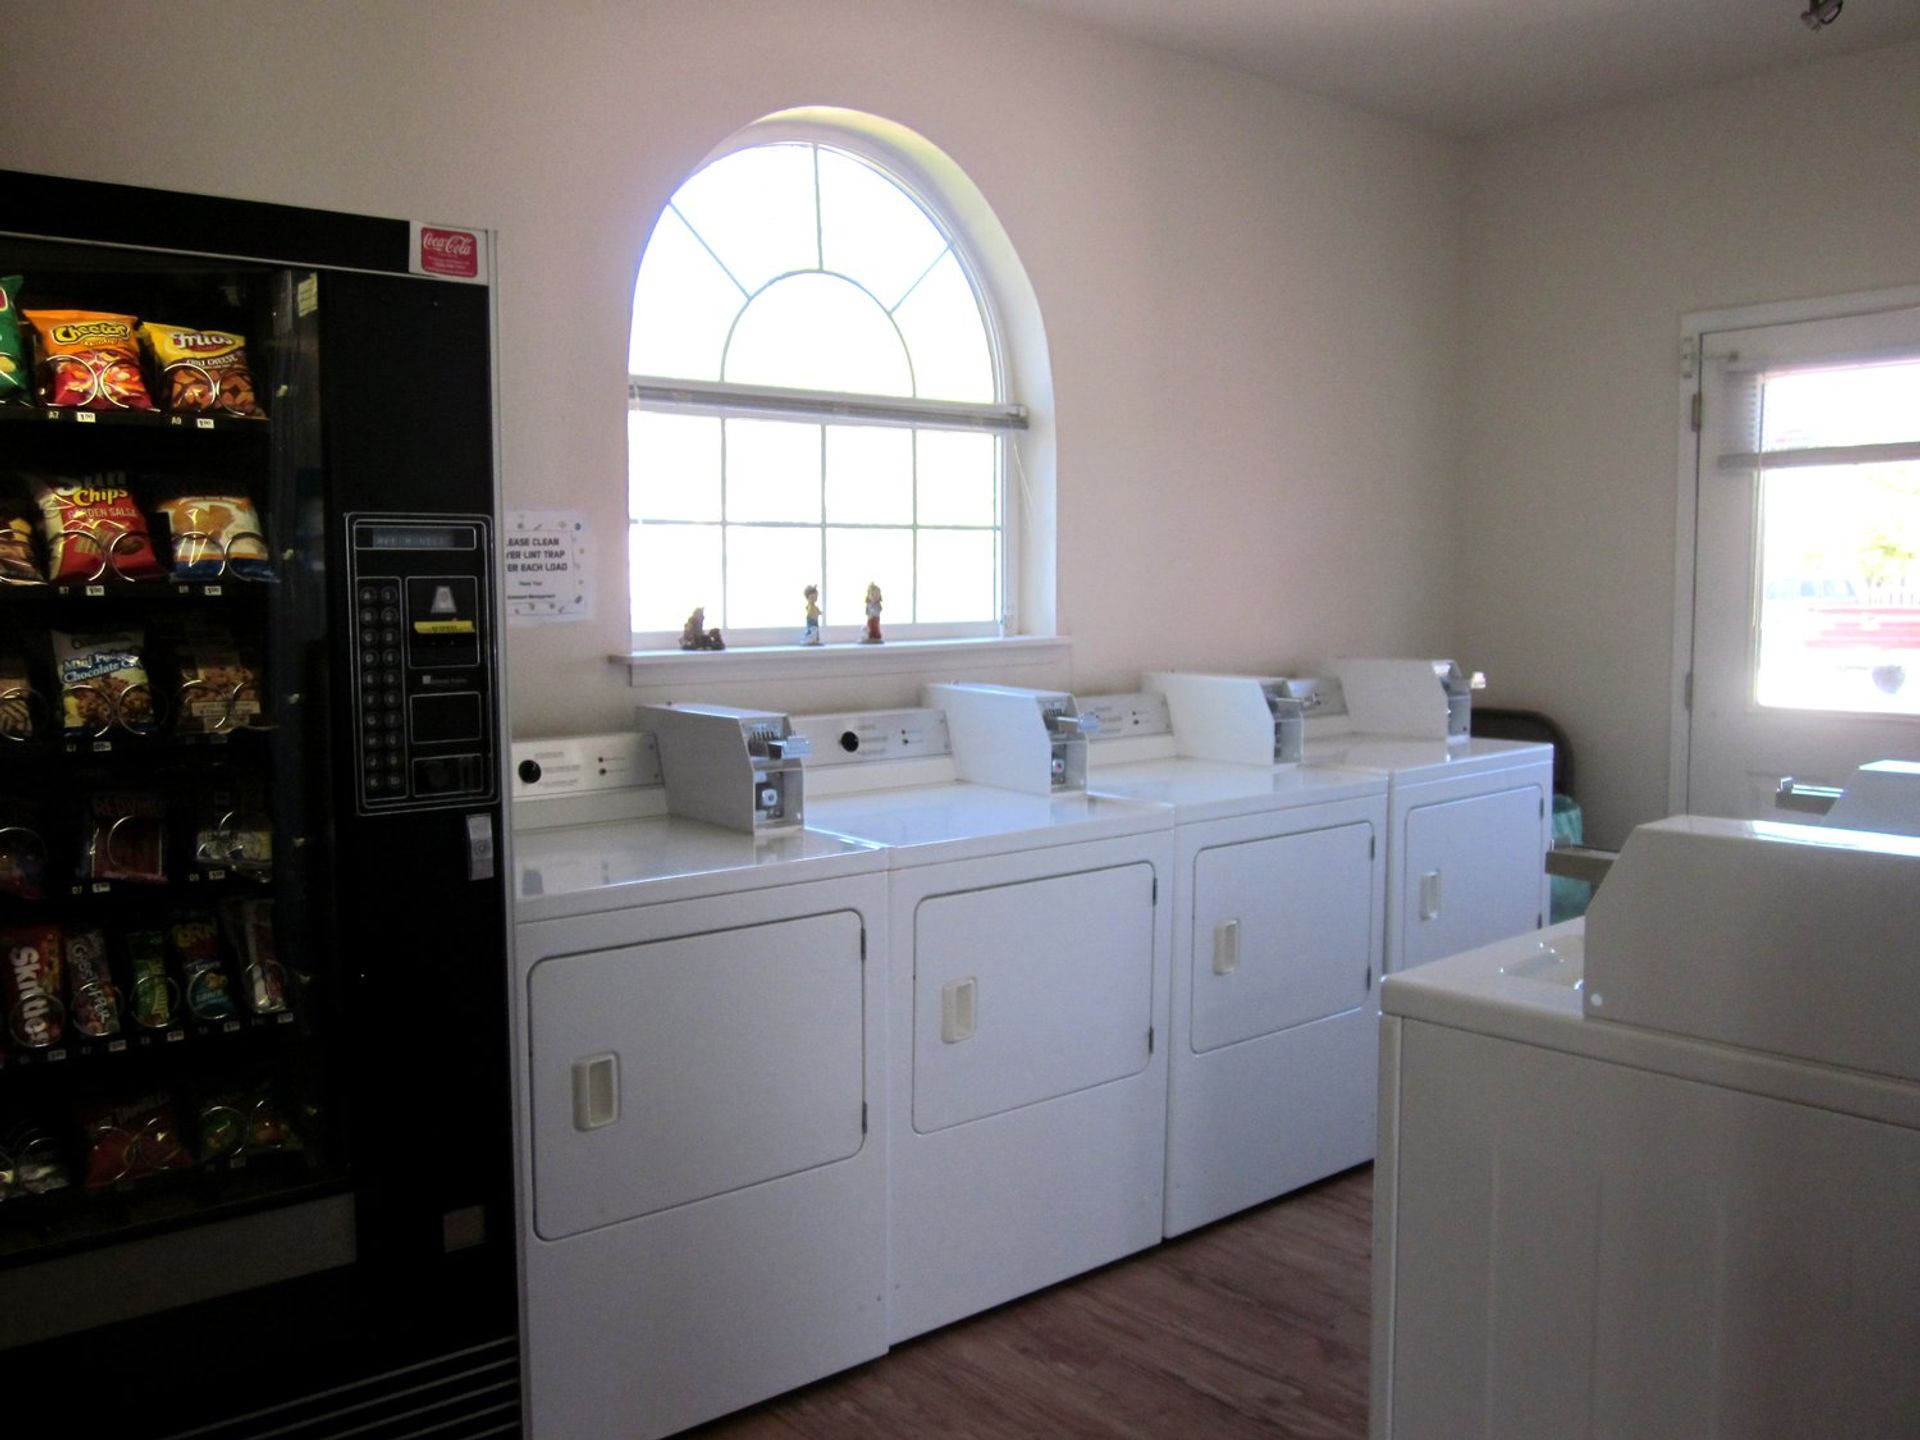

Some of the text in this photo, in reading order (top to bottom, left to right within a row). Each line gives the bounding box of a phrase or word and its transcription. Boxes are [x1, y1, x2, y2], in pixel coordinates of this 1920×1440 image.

[52, 322, 130, 344] Cheetos
[170, 333, 234, 349] Fritos
[73, 487, 129, 506] Chips
[506, 537, 560, 546] EASE CLEAN
[523, 550, 541, 559] LINT
[544, 550, 565, 559] TRAP
[521, 563, 543, 572] EACH
[545, 562, 568, 572] LOAD
[64, 662, 119, 682] Chocolate
[10, 945, 50, 1043] Skittles
